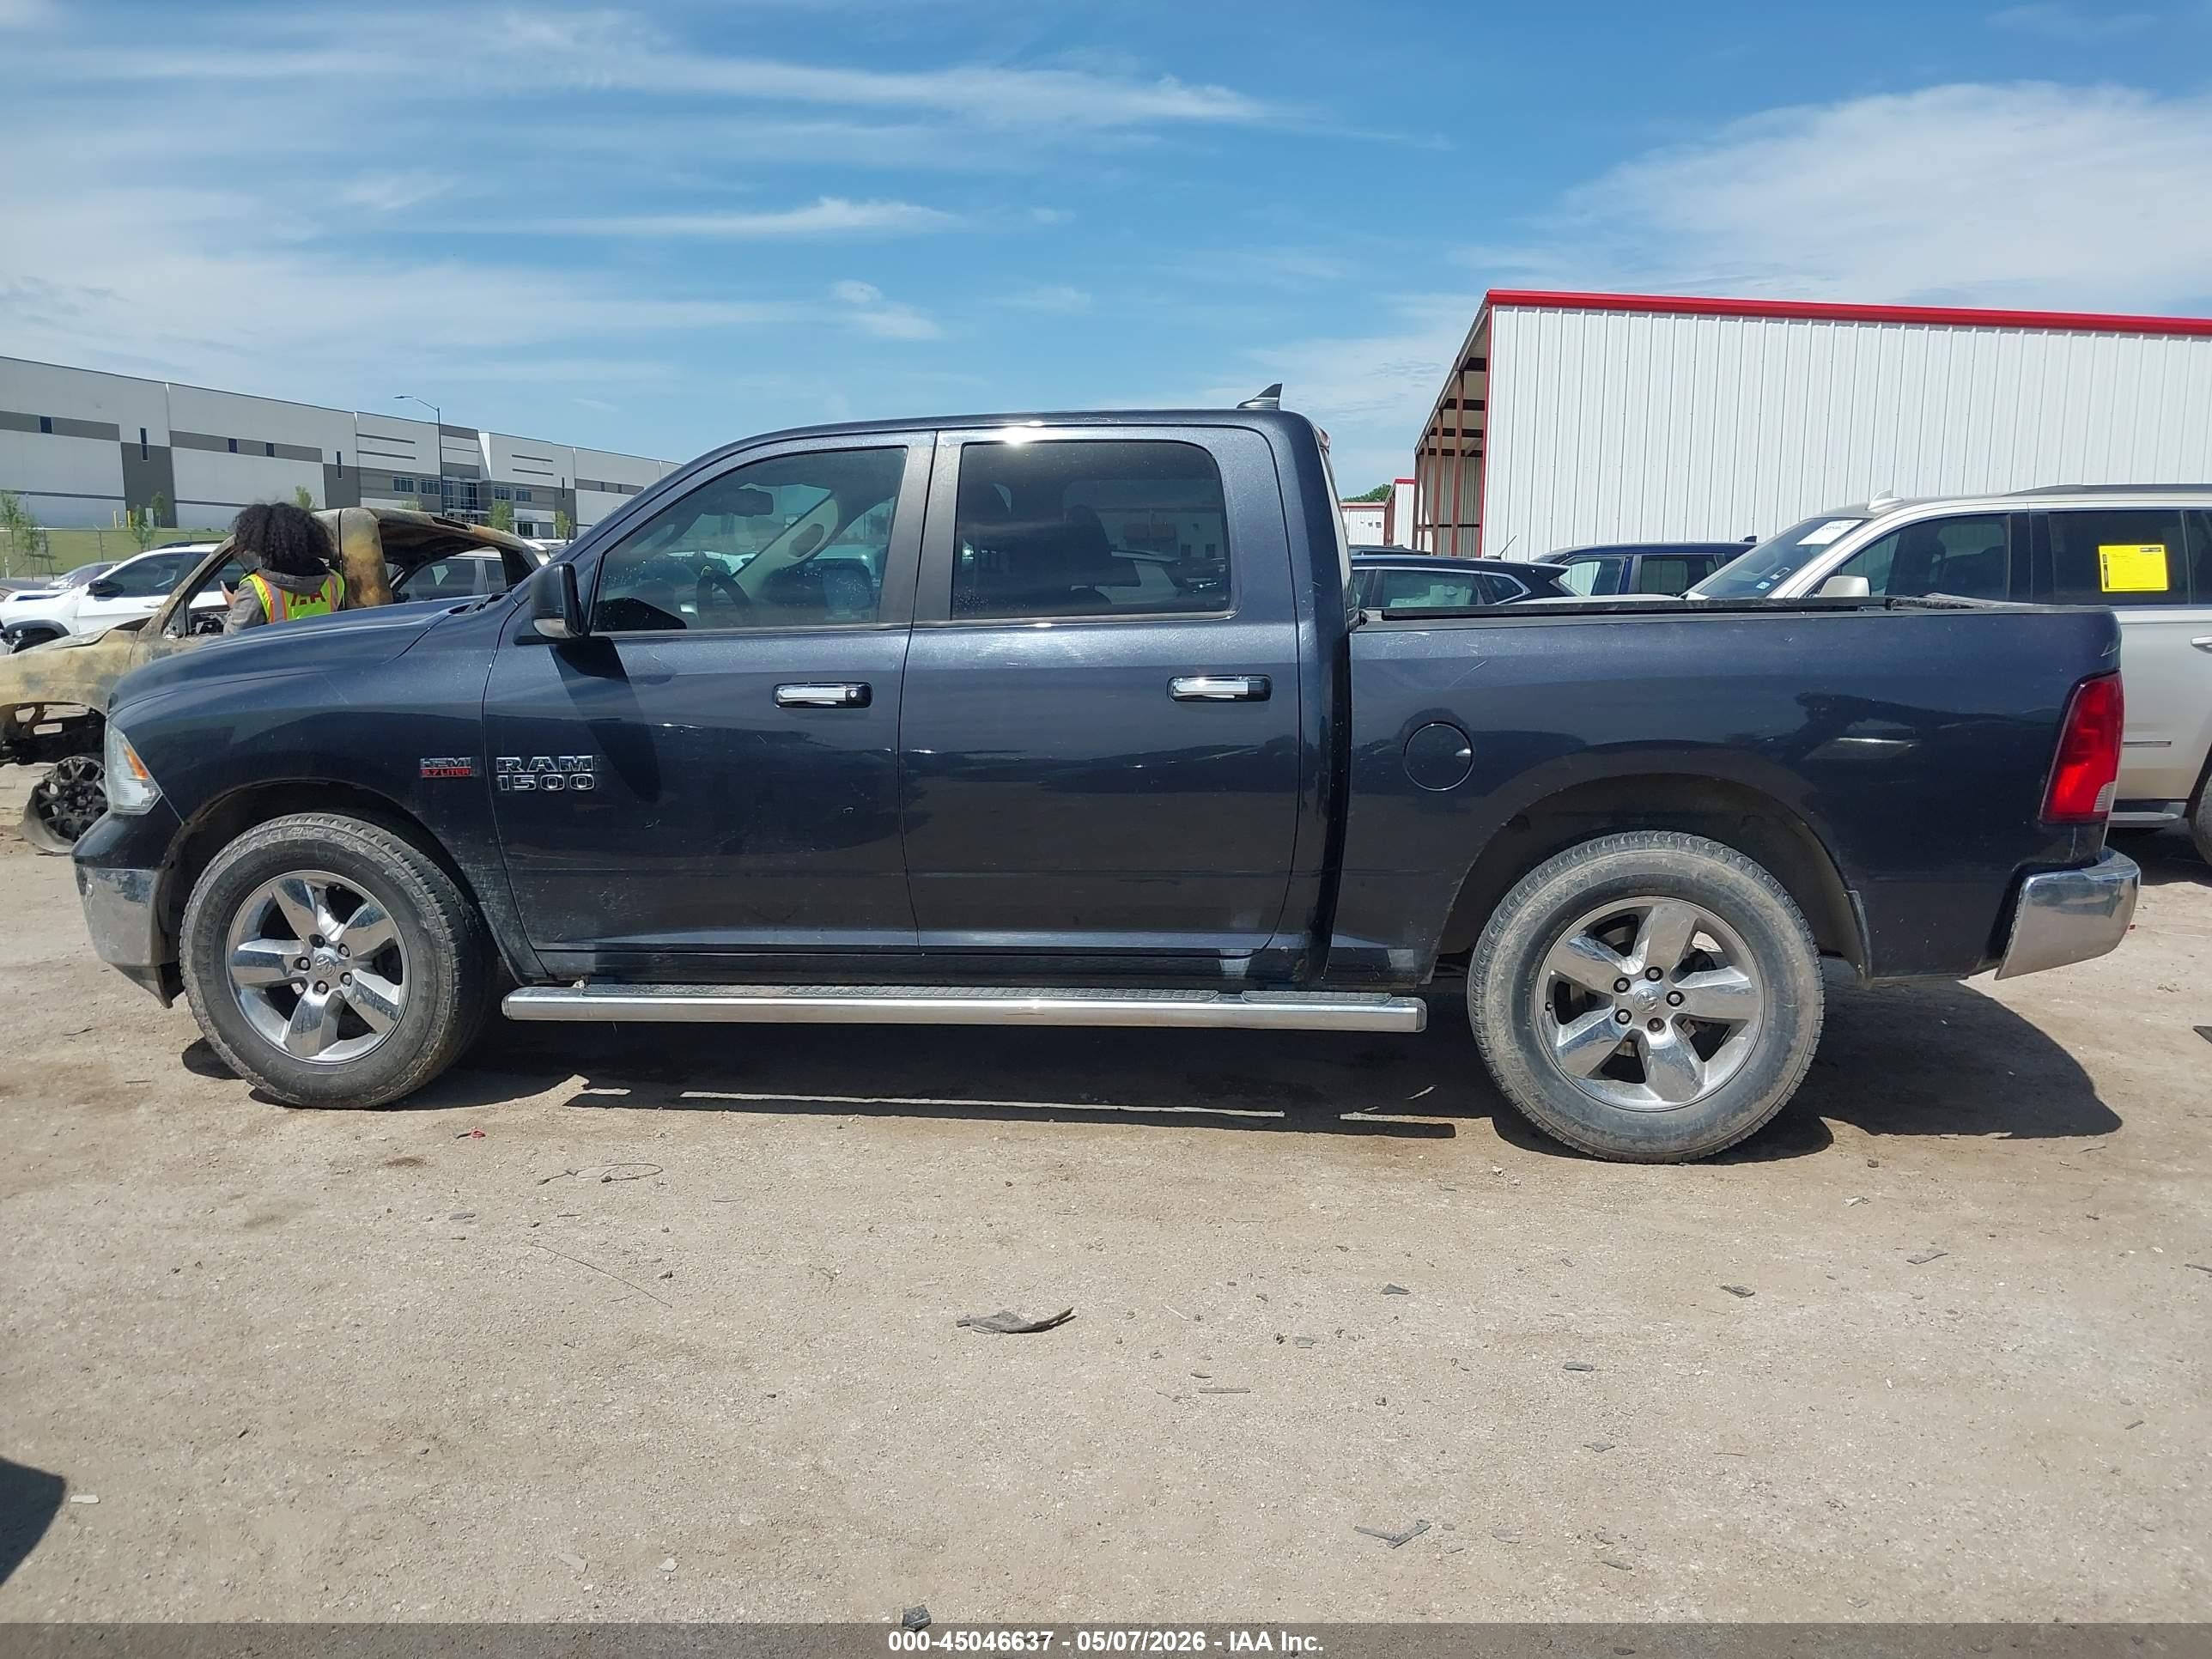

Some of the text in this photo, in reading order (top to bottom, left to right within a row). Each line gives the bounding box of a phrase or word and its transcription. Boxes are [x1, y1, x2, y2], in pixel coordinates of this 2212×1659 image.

[420, 757, 471, 769] HEMI
[496, 756, 594, 773] RAM
[498, 774, 595, 791] 1500
